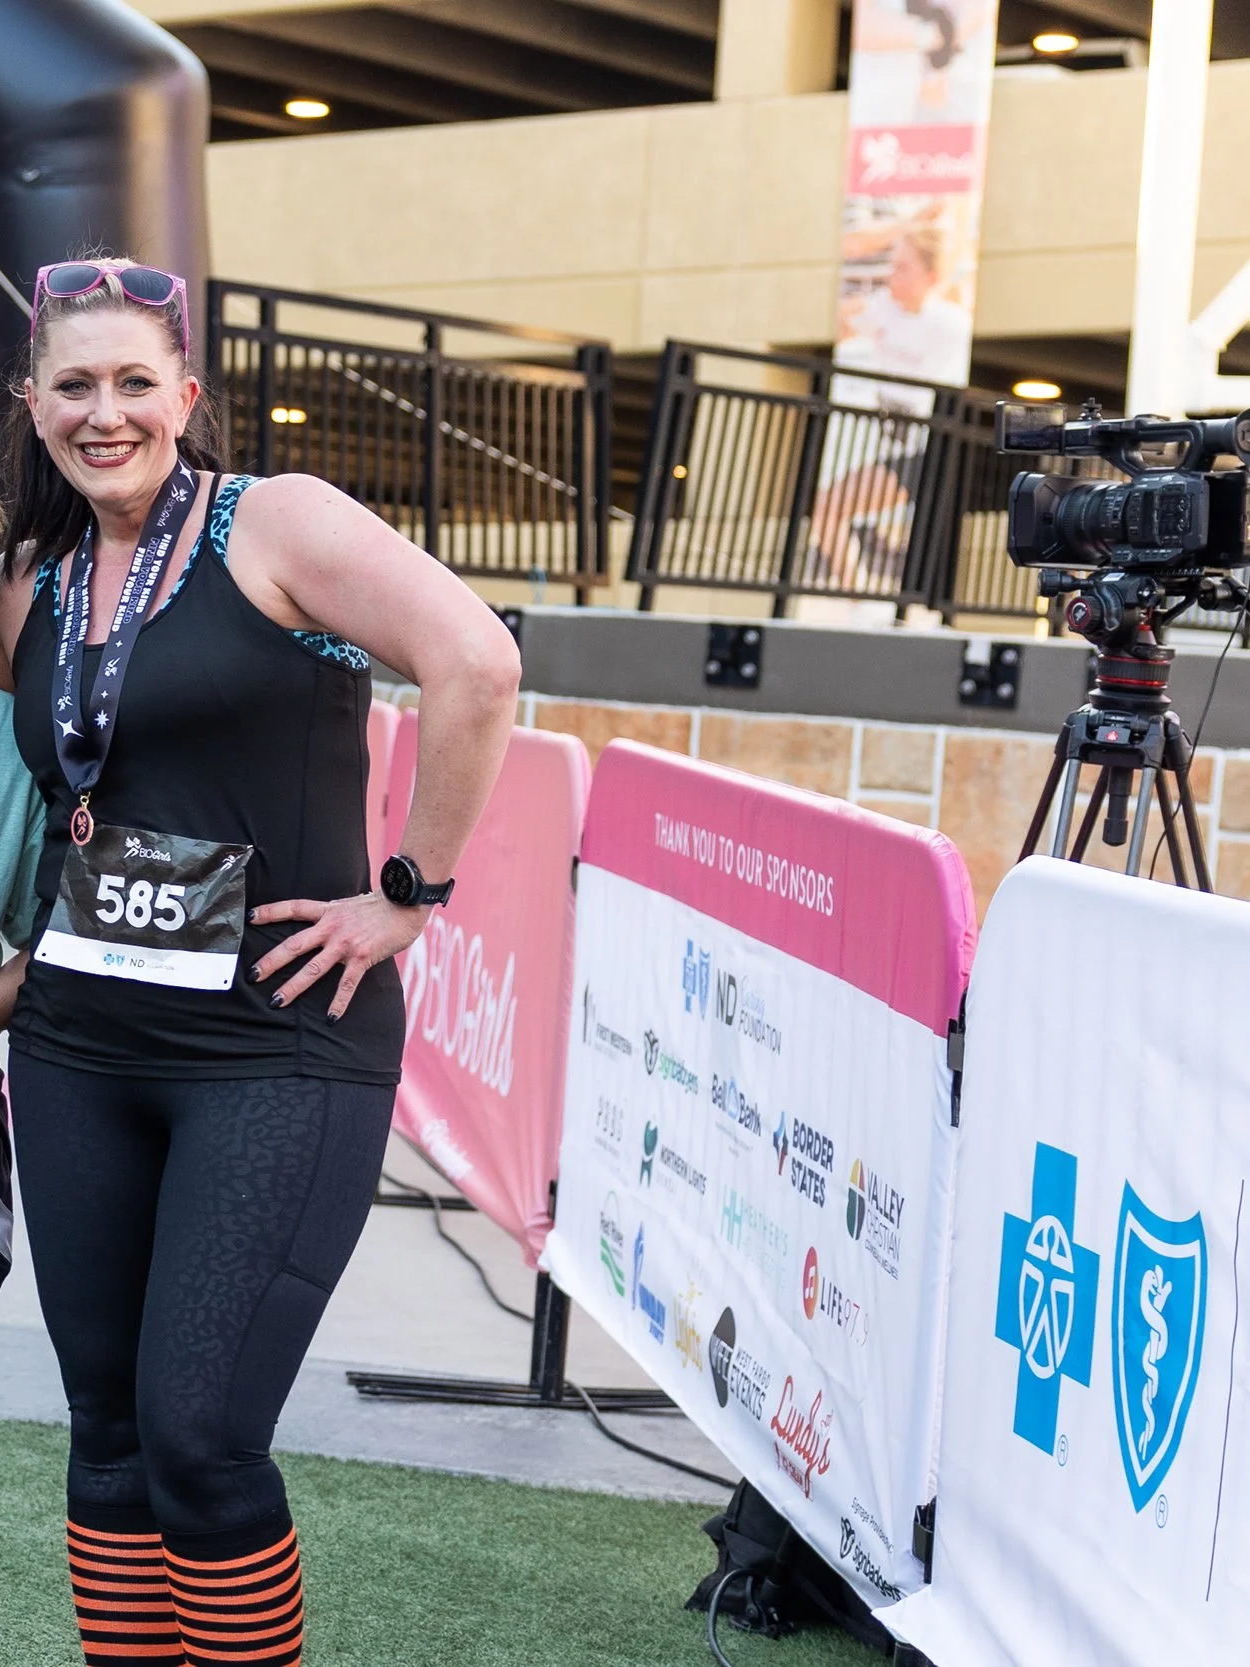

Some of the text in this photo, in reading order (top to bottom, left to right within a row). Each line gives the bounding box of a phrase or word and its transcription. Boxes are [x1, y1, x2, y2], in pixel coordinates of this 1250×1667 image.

[77, 562, 93, 641] FIND YOUR KIND
[111, 547, 146, 632] FIND YOUR KIND
[123, 537, 160, 624] FIND YOUR KIND
[136, 533, 172, 613] FIND YOUR KIND
[58, 587, 75, 666] FIND YOUR KIND
[654, 811, 834, 917] THANK YOU TO OUR SPONSORS
[95, 873, 186, 932] 585
[129, 958, 145, 968] ND
[716, 967, 738, 1026] ND
[738, 1009, 782, 1056] FOUNDATION
[711, 1072, 762, 1138] Bell Bank
[792, 1117, 834, 1173] BORDER
[790, 1160, 826, 1208] STATES
[867, 1166, 905, 1229] VALLEY
[736, 1346, 752, 1371] WEST
[729, 1363, 766, 1421] EVENTS
